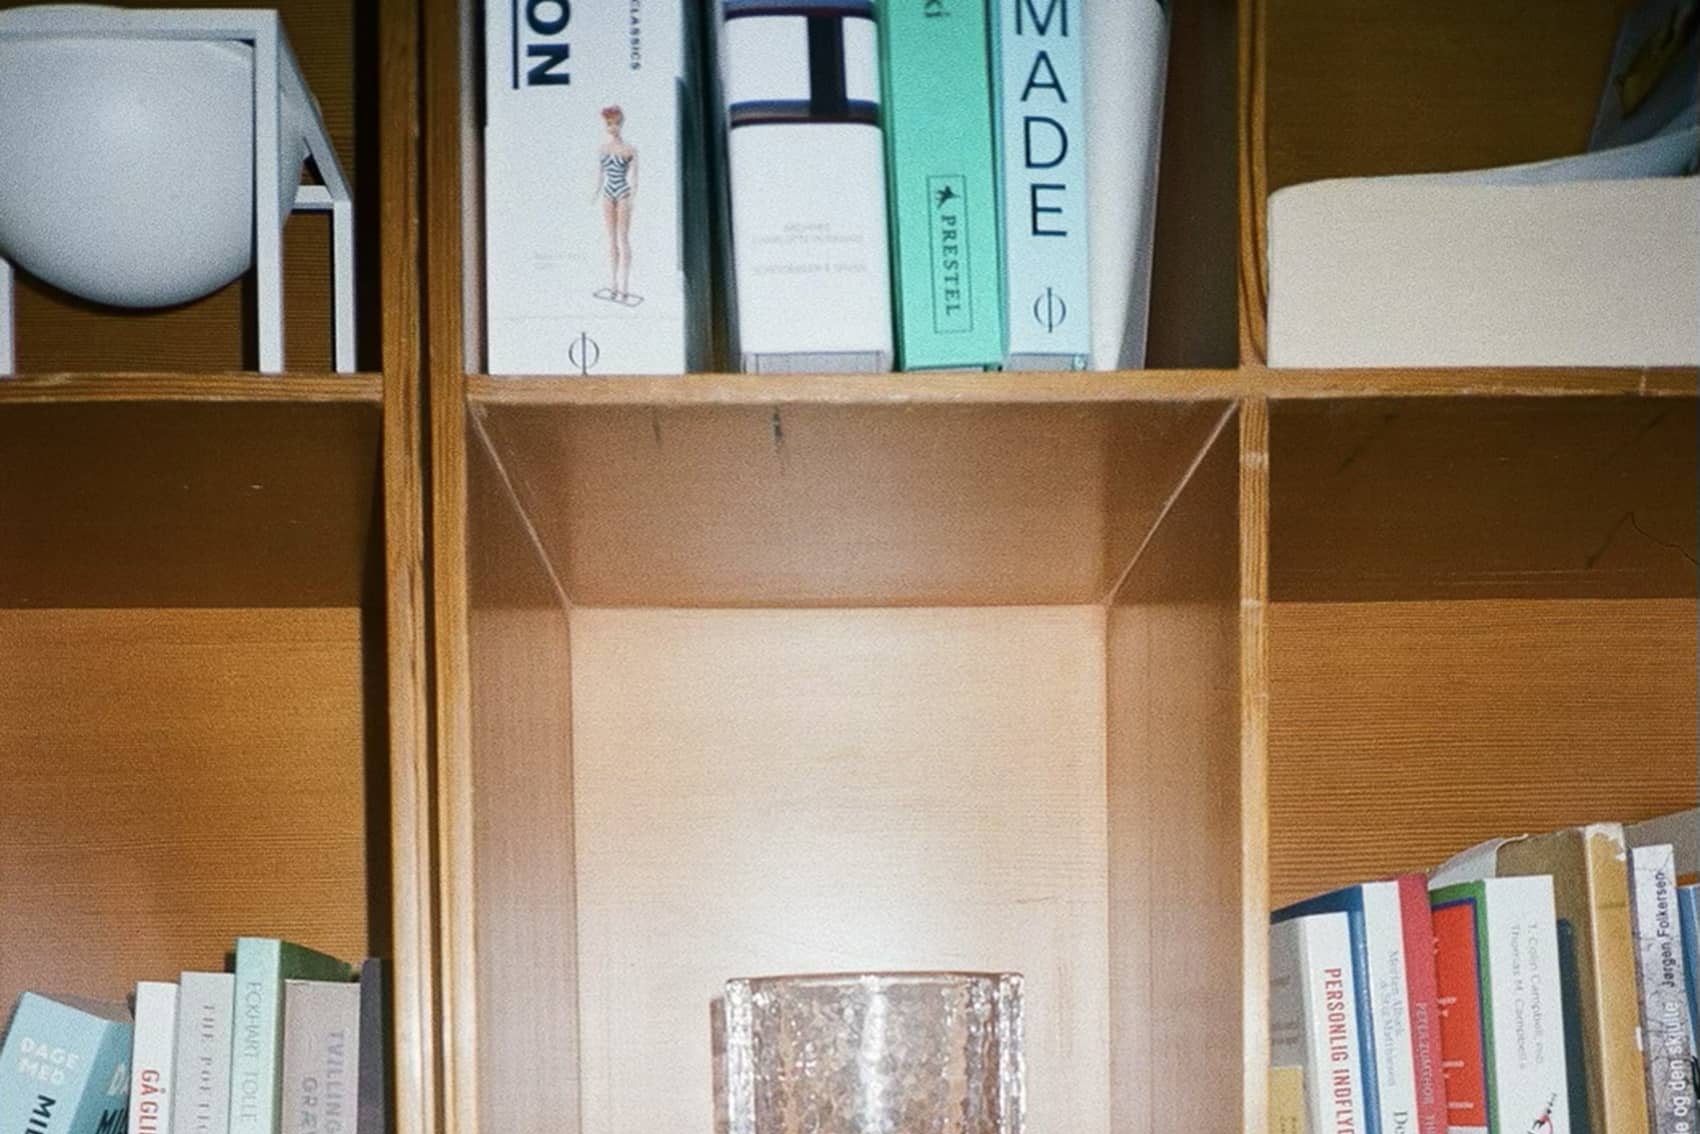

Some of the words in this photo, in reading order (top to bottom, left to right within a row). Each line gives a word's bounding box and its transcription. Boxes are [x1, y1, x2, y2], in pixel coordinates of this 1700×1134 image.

[941, 215, 961, 316] PRESTEL
[1655, 871, 1670, 939] Folkersen
[1661, 940, 1676, 988] Jørgen
[203, 1005, 215, 1039] THE
[243, 981, 262, 1059] ECKHART
[1324, 968, 1349, 1062] PERSONLIG
[1663, 1001, 1685, 1055] skjulte
[18, 1057, 65, 1086] MED
[20, 1037, 80, 1069] DAGE
[1669, 1059, 1686, 1091] den
[140, 1069, 166, 1098] GÅ
[240, 1077, 258, 1122] TOLLE
[1673, 1096, 1690, 1117] og
